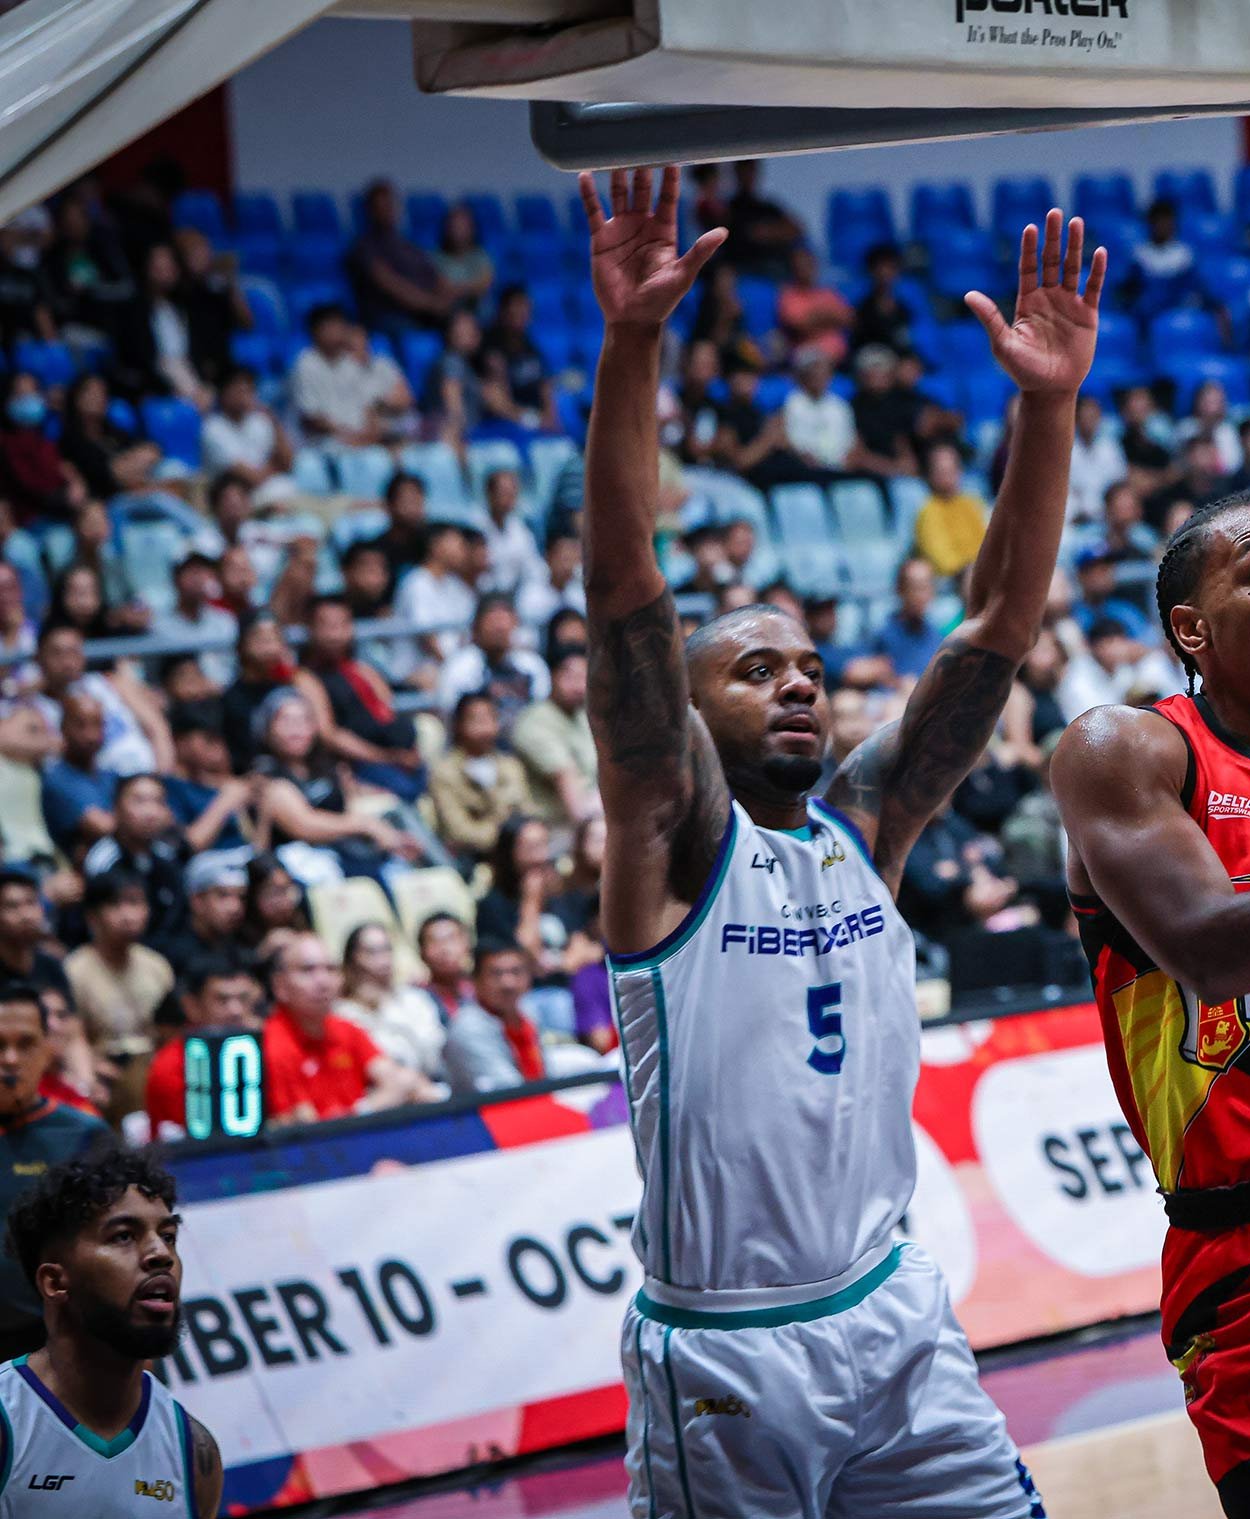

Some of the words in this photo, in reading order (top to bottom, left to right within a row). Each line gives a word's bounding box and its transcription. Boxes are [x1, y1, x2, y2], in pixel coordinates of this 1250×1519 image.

[989, 26, 1018, 45] What
[1021, 28, 1038, 45] the
[1041, 28, 1066, 47] Pros
[1069, 30, 1093, 52] Play
[806, 981, 846, 1075] 5
[336, 1258, 435, 1346] 10
